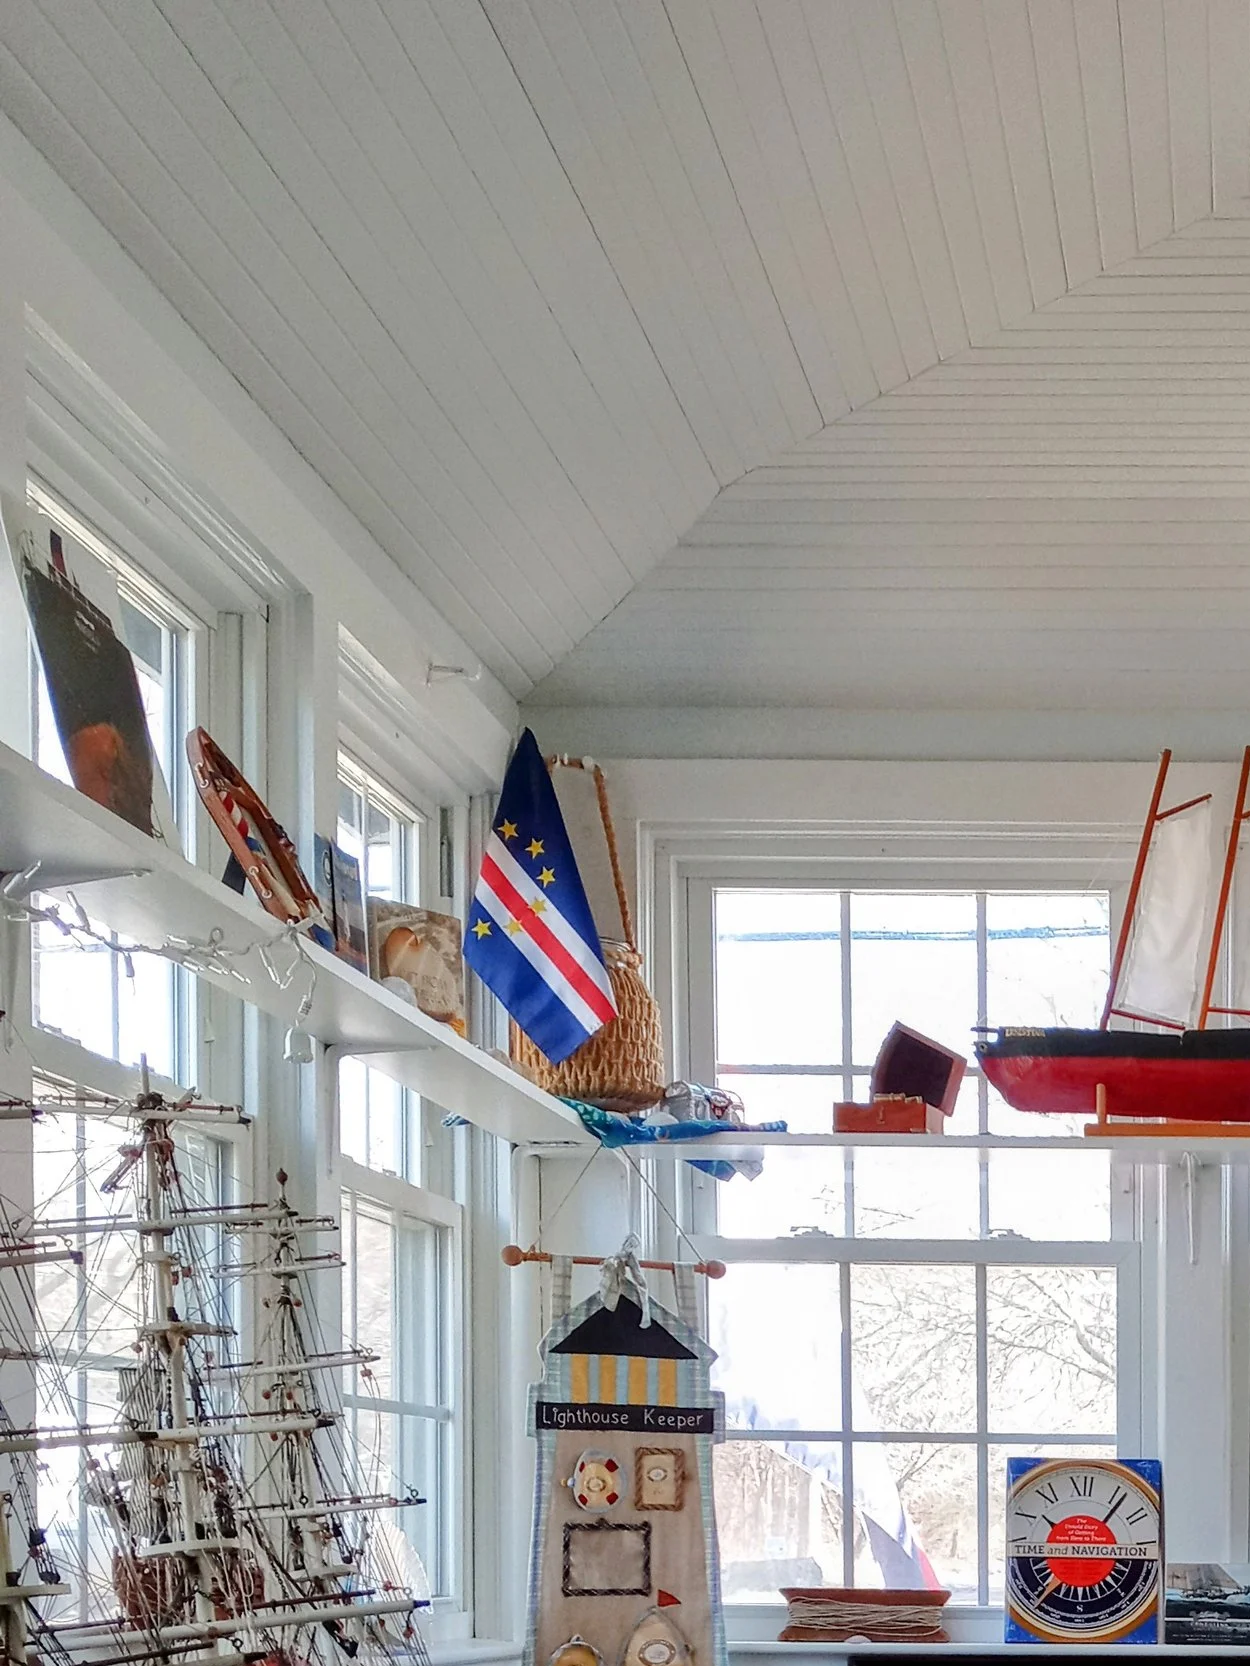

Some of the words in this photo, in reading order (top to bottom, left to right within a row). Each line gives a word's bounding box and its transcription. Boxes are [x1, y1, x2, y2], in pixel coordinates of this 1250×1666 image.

[542, 1405, 629, 1427] Lighthouse
[644, 1409, 704, 1429] Keeper
[1069, 1475, 1095, 1498] XII
[1014, 1544, 1045, 1555] TIME
[1047, 1545, 1068, 1555] and
[1071, 1546, 1147, 1557] NAVIGATION
